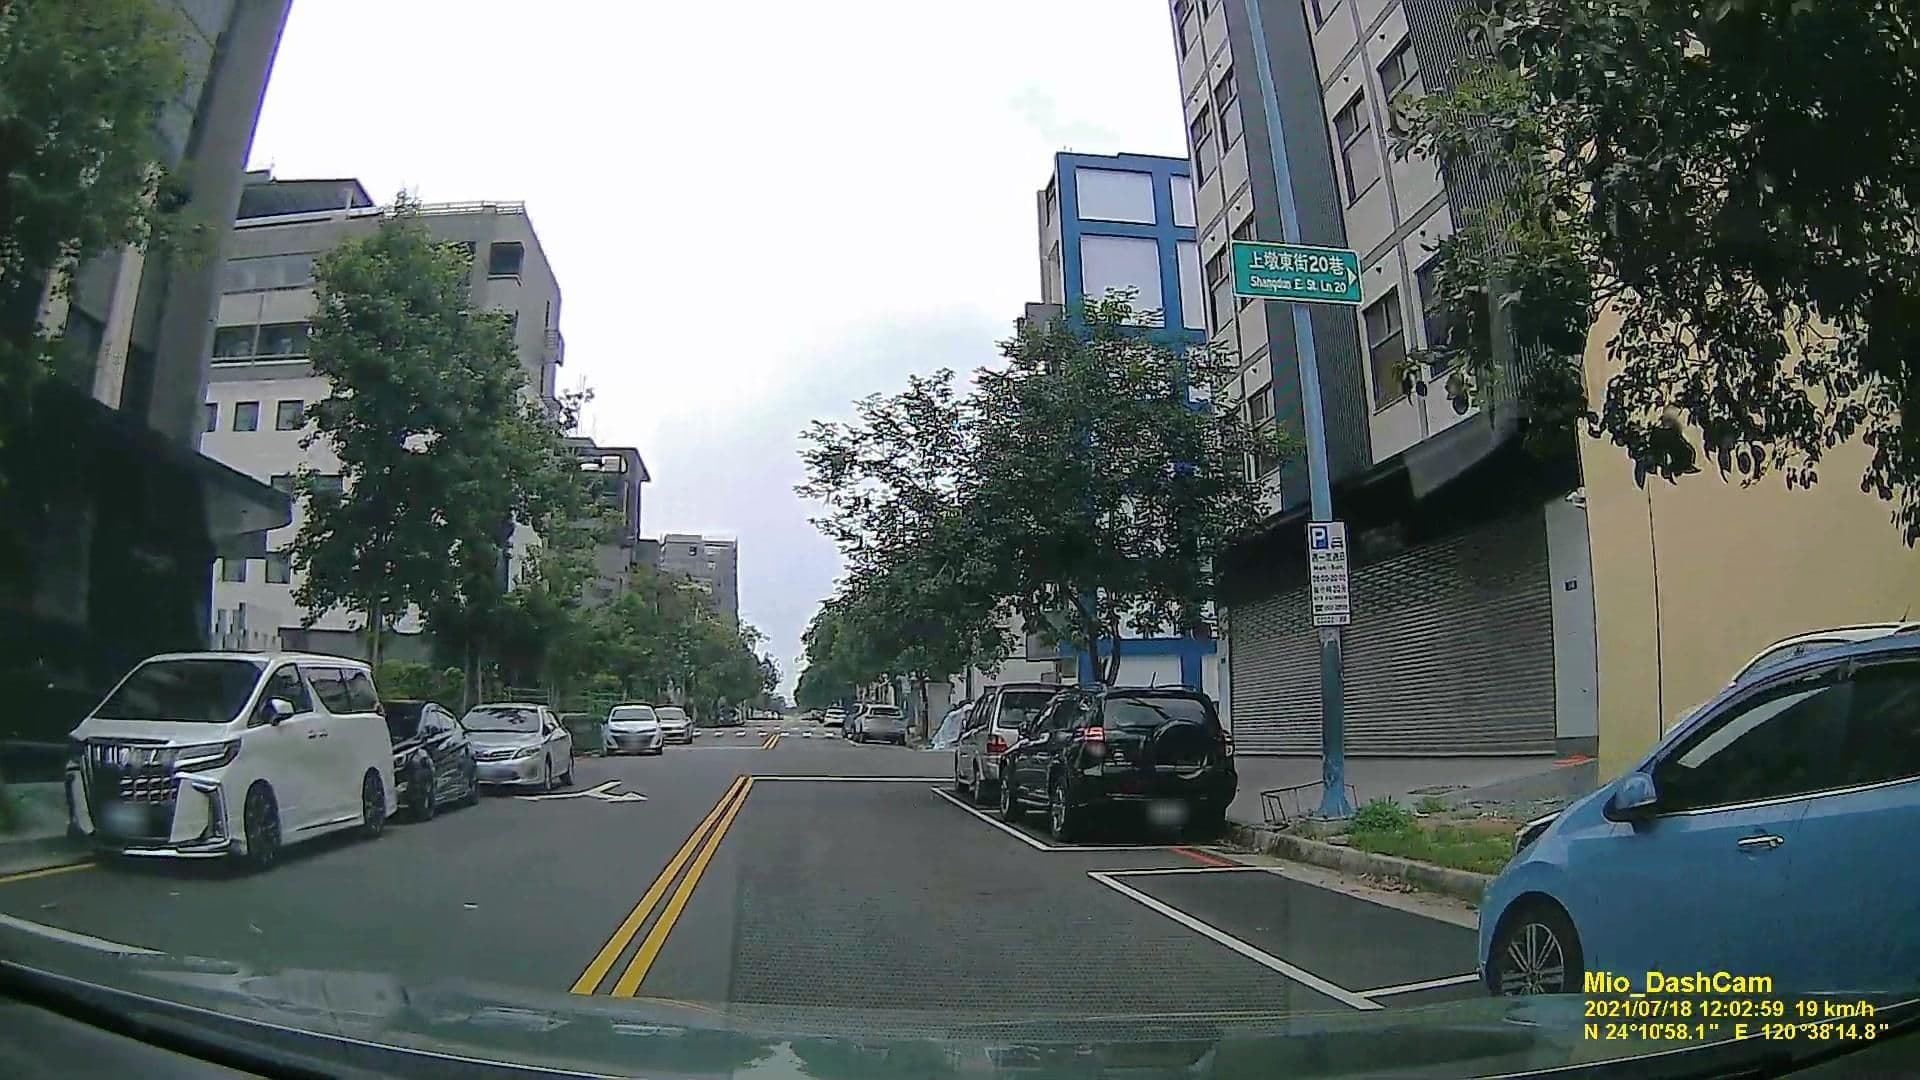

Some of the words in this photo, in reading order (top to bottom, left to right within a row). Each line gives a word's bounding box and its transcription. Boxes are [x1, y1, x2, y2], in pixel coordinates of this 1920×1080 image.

[1249, 252, 1344, 275] 上墩東街20巷
[1250, 275, 1292, 292] Shangdun
[1334, 282, 1346, 293] 20
[1312, 528, 1325, 549] P
